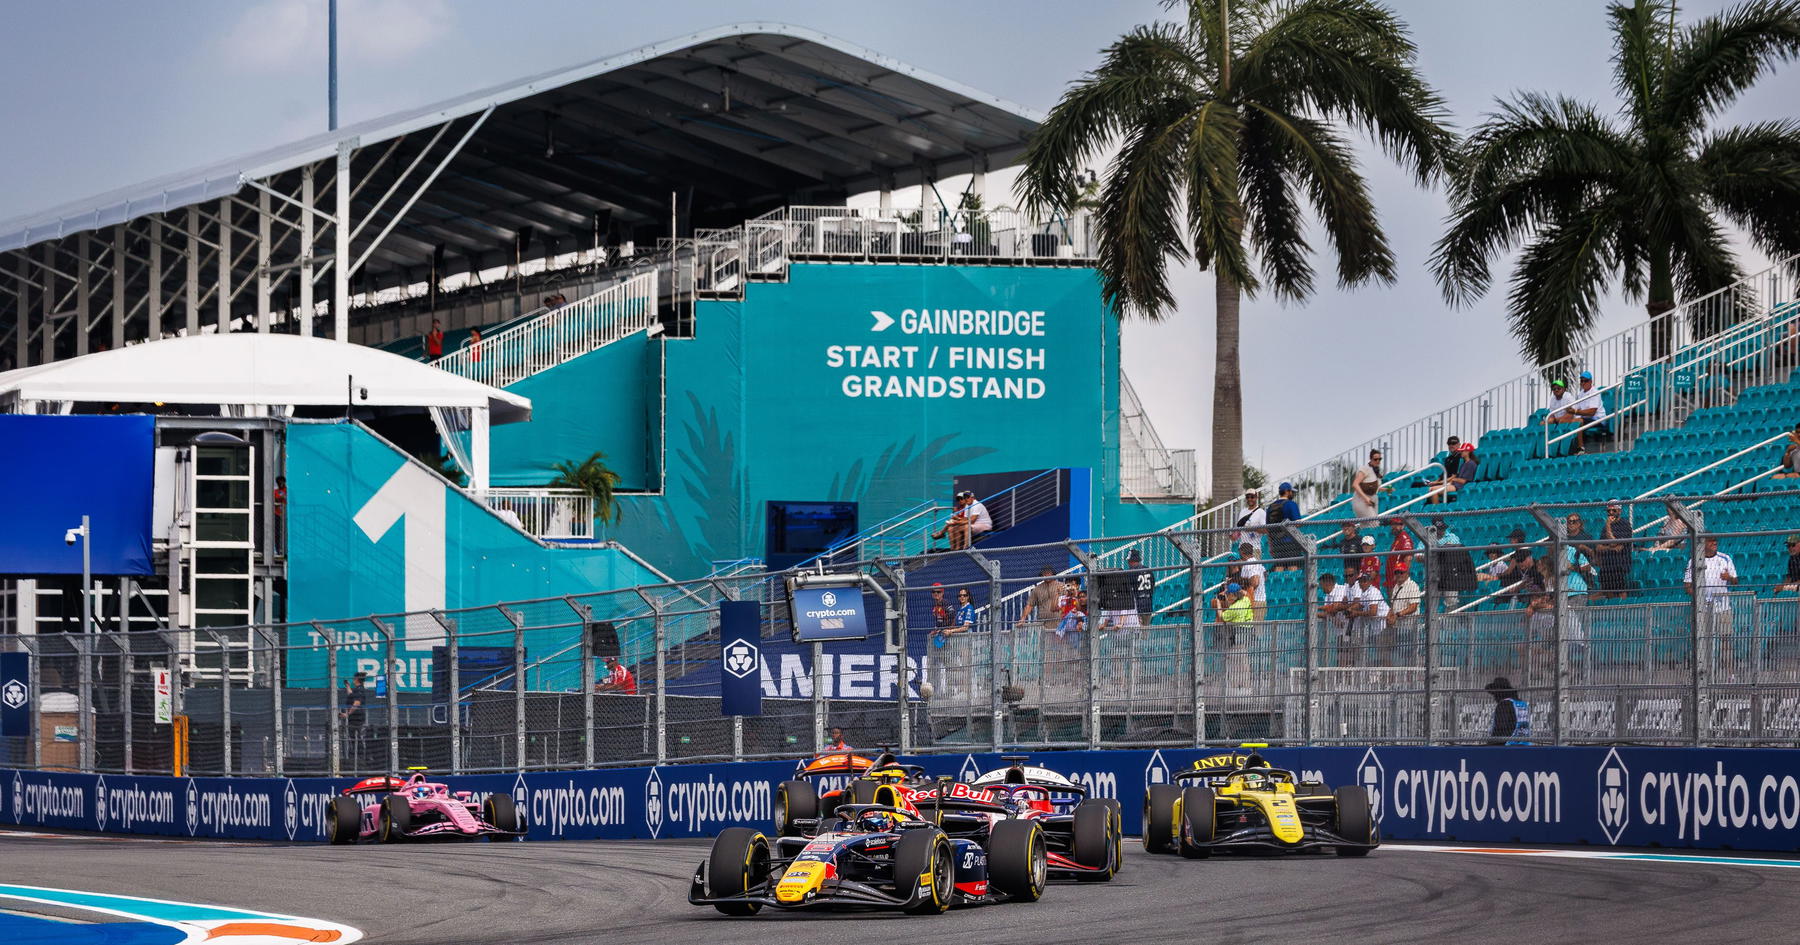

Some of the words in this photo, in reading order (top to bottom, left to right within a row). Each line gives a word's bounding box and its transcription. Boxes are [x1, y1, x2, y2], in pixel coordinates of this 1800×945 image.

[901, 309, 1046, 336] GAINBRIDGE
[826, 345, 919, 368] START
[949, 347, 1045, 370] FINISH
[841, 375, 1046, 399] GRANDSTAND
[353, 461, 446, 651] 1
[1137, 574, 1151, 591] 25
[806, 607, 856, 619] crypto.com
[308, 631, 379, 651] TURN
[25, 779, 84, 822] crypto.com
[110, 783, 174, 829] crypto.com
[201, 785, 271, 833] crypto.com
[533, 780, 625, 836] crypto.com
[668, 773, 771, 832] crypto.com
[950, 783, 995, 803] Bull
[1394, 759, 1560, 833] crypto.com
[1640, 761, 1800, 840] crypto.co
